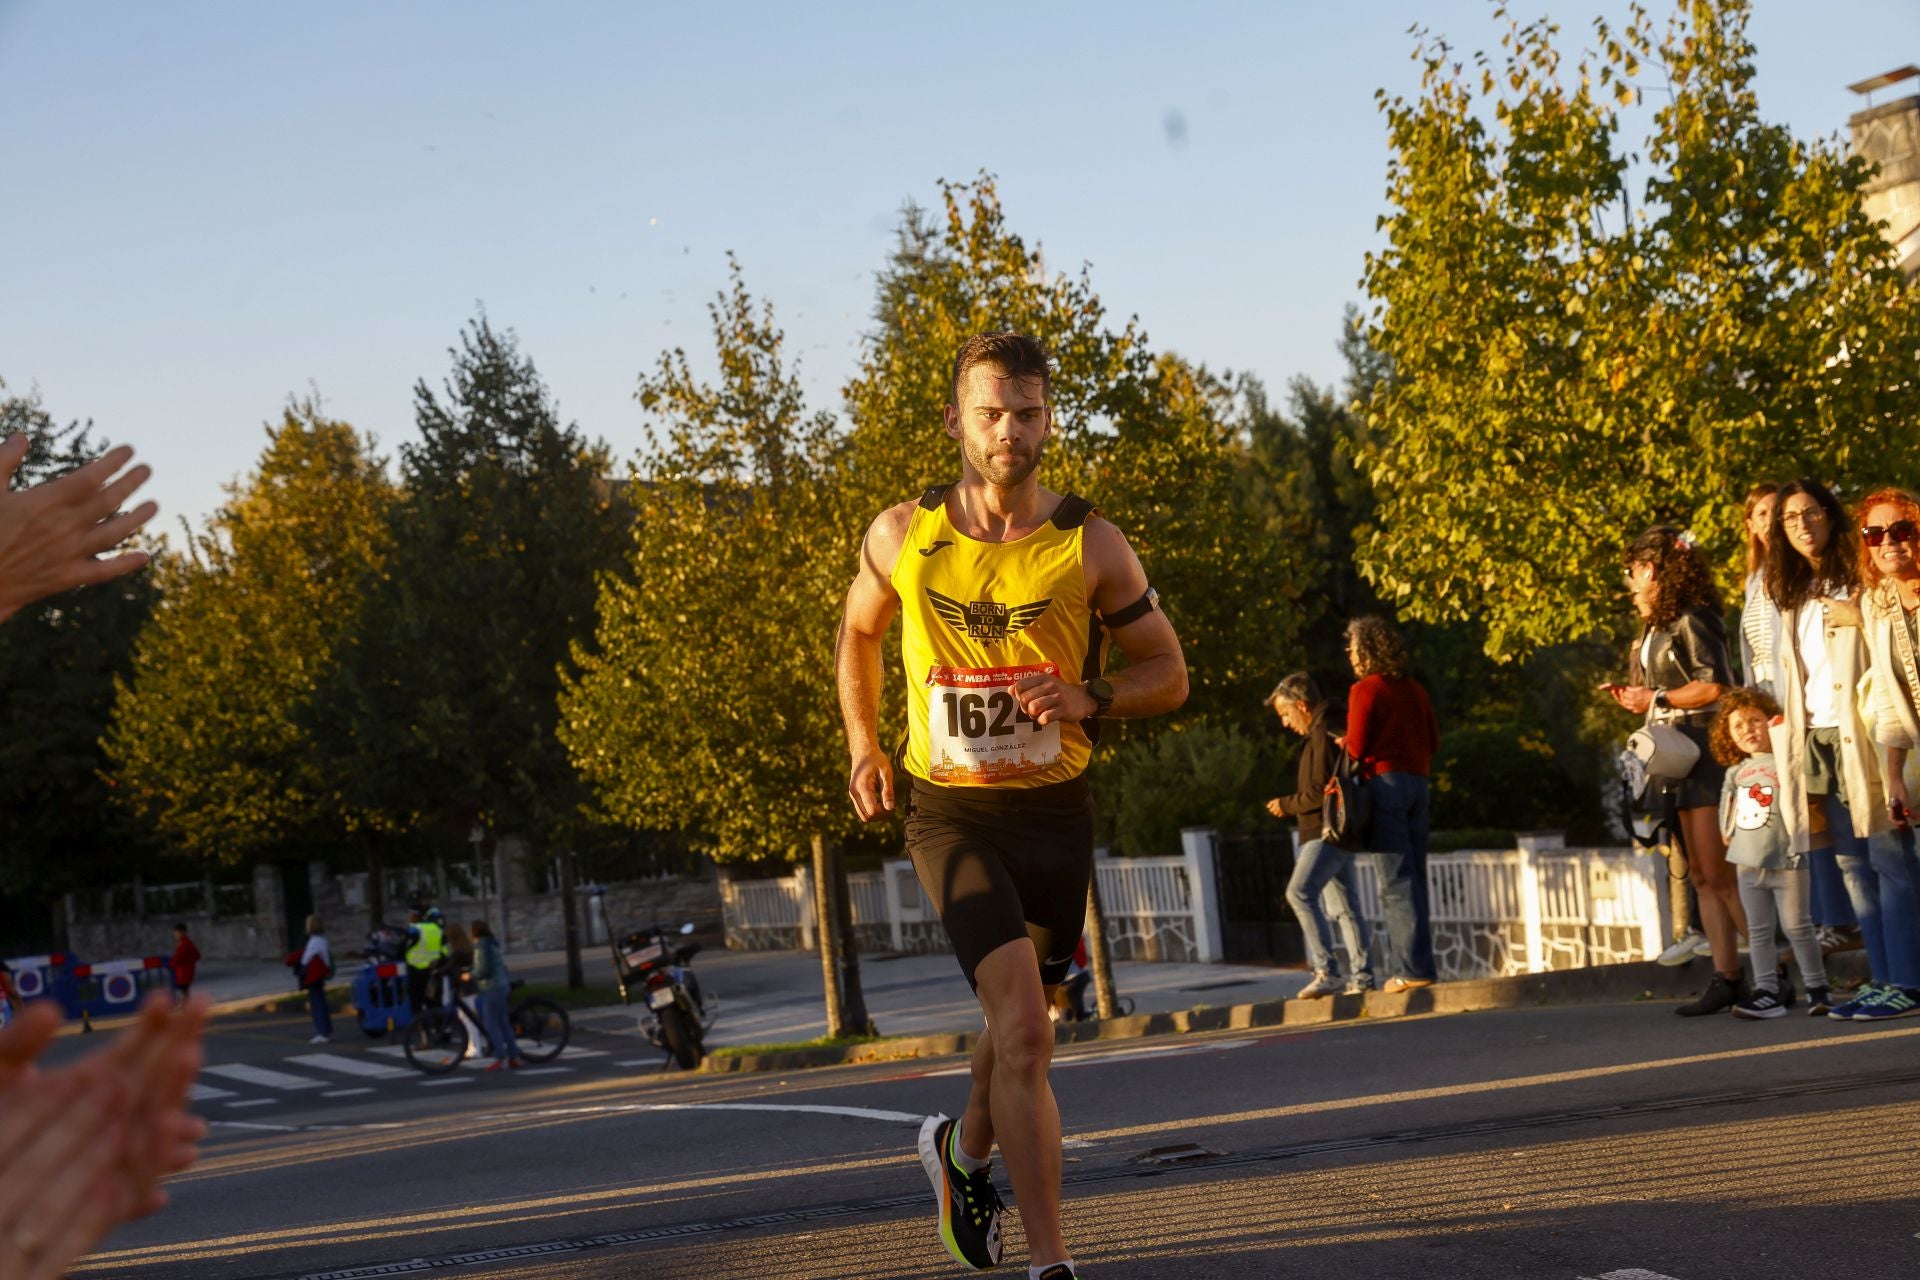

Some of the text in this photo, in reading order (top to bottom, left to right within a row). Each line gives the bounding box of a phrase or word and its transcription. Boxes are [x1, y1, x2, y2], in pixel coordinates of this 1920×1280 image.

[971, 604, 1003, 615] BORN
[980, 616, 993, 624] TO
[971, 625, 1003, 636] RUN
[965, 674, 991, 683] MBA
